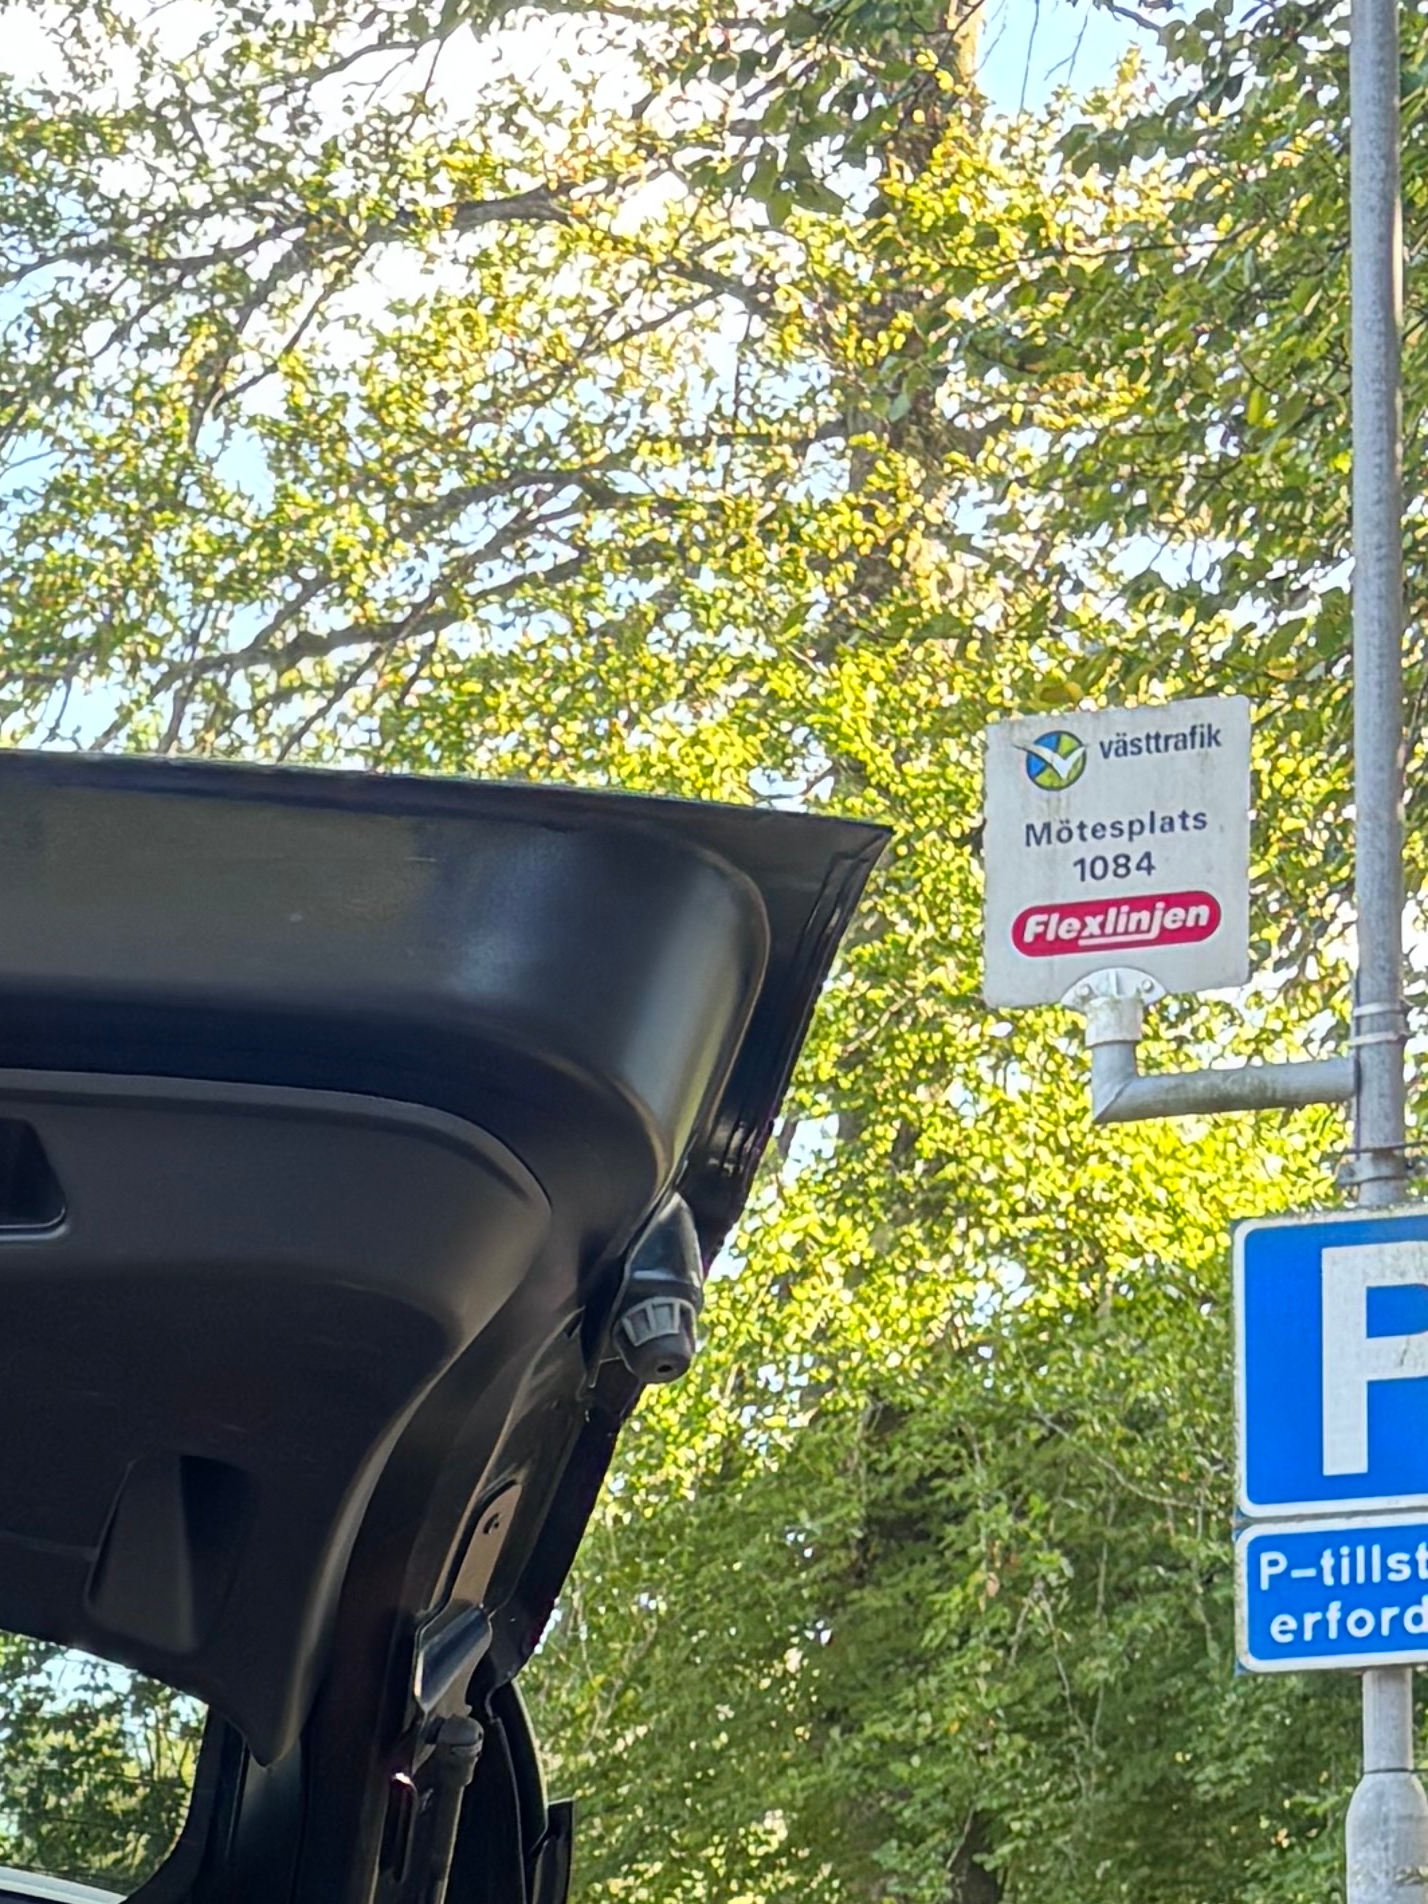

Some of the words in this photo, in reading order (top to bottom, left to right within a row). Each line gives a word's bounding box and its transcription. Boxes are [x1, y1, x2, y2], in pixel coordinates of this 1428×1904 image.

[1099, 723, 1222, 759] västtrafik
[1025, 809, 1208, 848] Mötesplats
[1073, 850, 1156, 882] 1084
[1023, 901, 1210, 946] Flexlinjen
[1321, 1240, 1428, 1476] P
